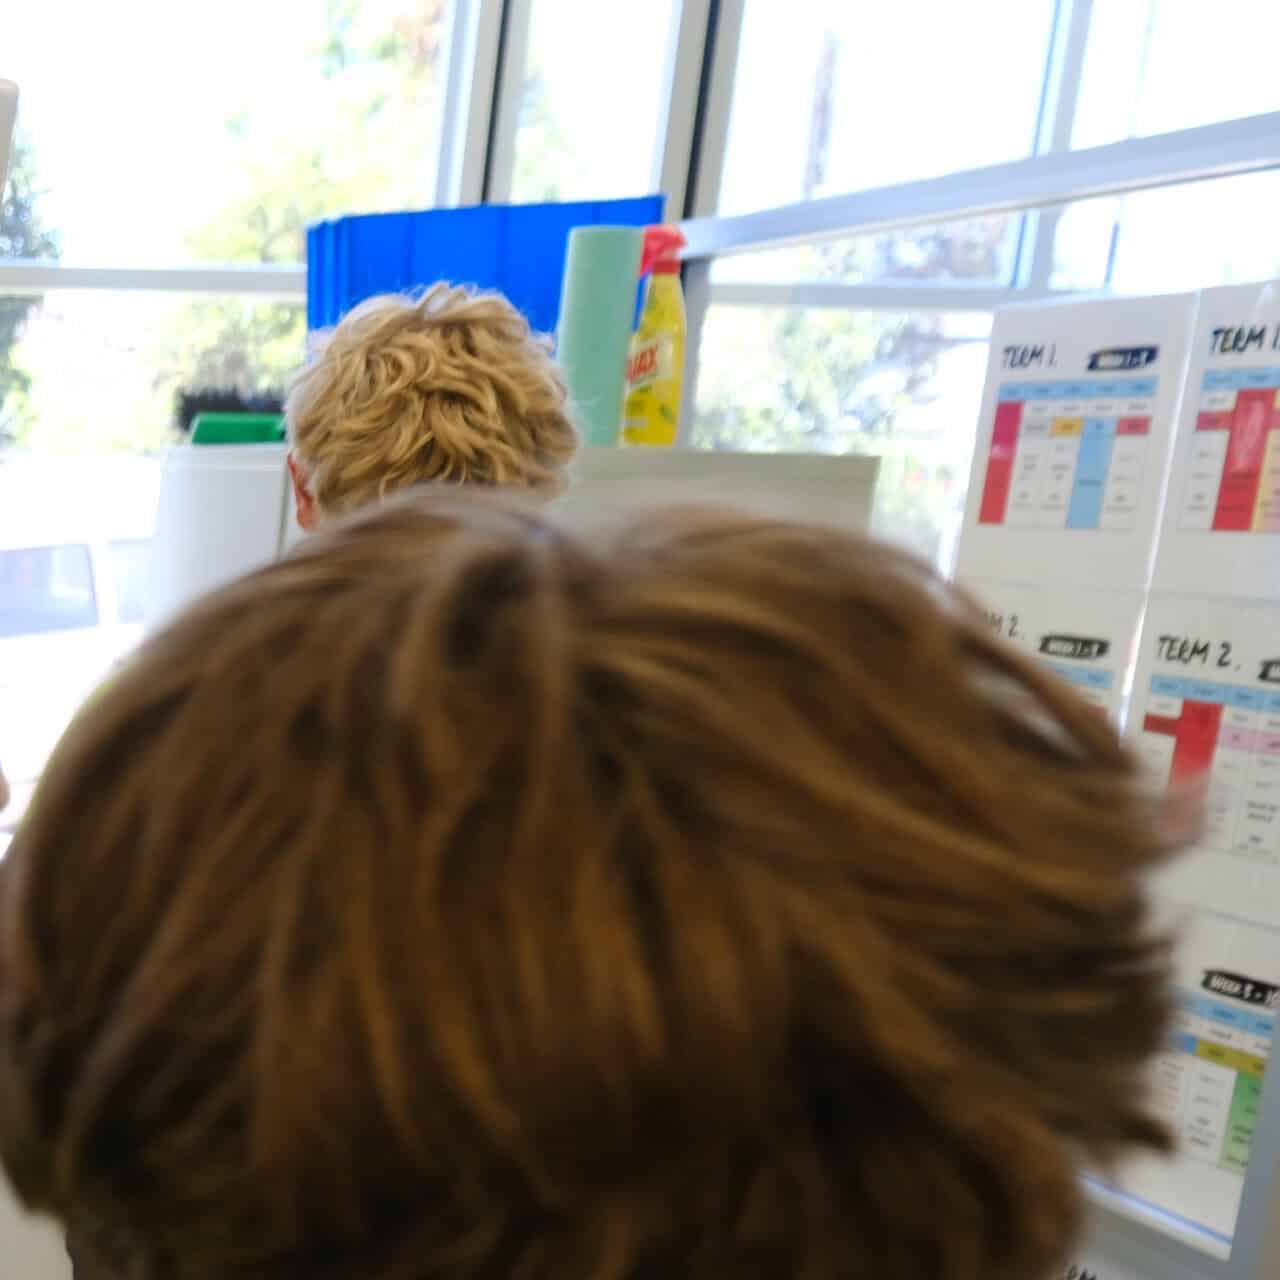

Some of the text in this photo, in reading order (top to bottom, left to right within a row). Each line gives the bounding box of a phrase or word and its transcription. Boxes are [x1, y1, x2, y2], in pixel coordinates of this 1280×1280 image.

[1209, 325, 1266, 354] TERM
[1003, 344, 1046, 369] TERM
[1157, 635, 1209, 665] TERM
